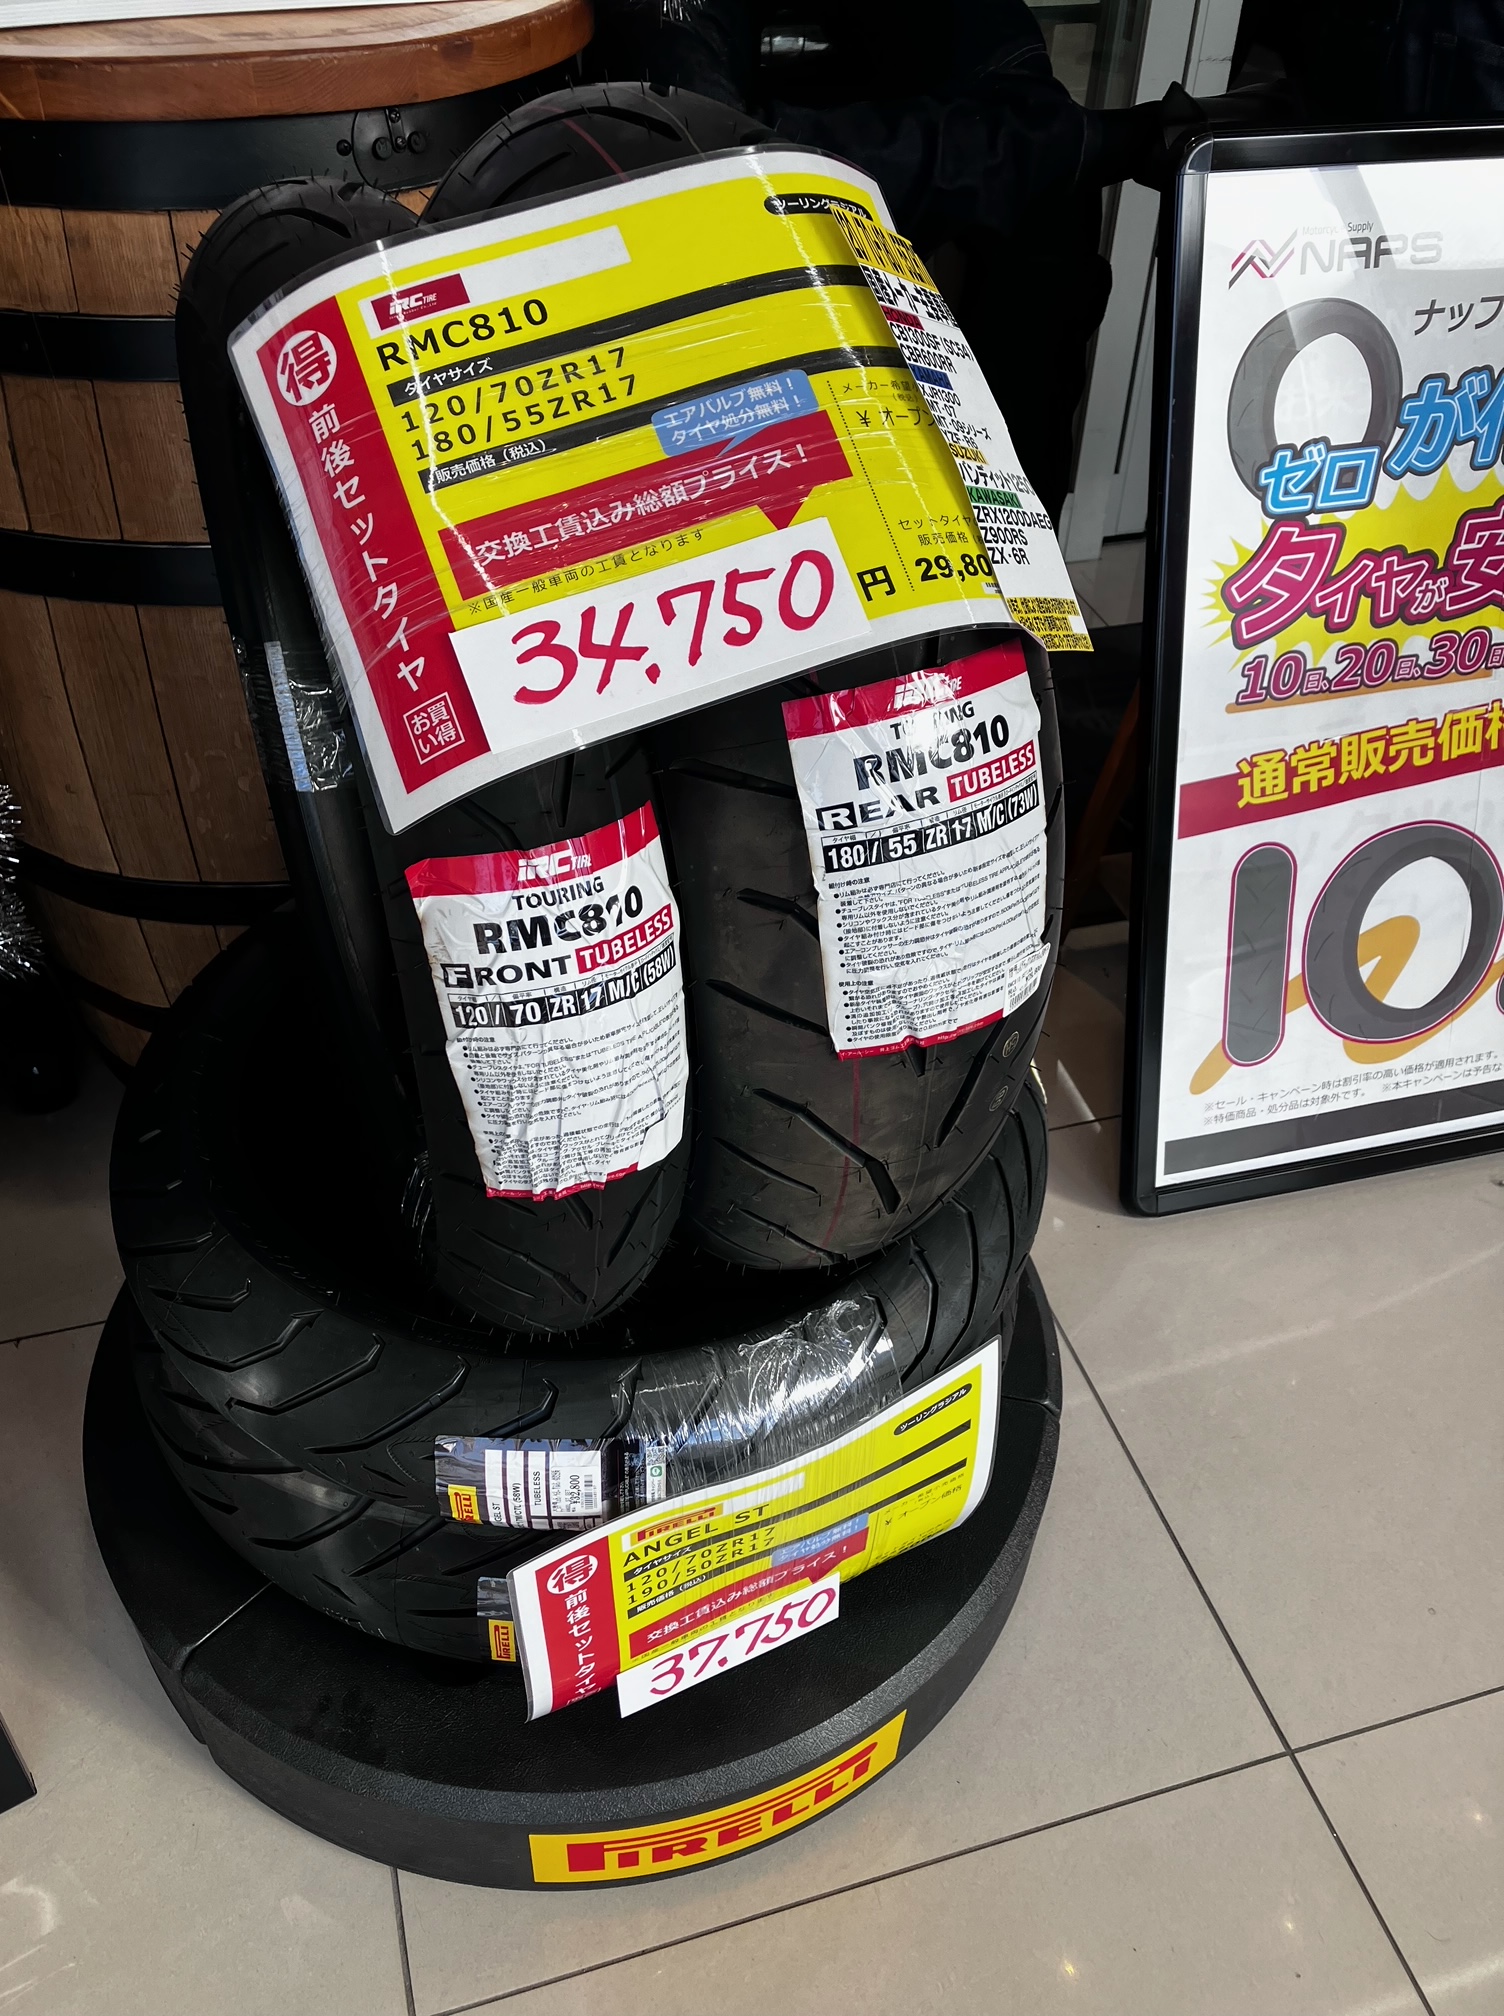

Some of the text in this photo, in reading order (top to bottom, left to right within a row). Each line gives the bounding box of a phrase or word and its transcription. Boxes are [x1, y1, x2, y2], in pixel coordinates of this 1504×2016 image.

[1347, 221, 1374, 233] Supply
[1300, 231, 1443, 275] NAPS
[376, 299, 549, 371] RMC810
[883, 306, 923, 330] HONDA
[890, 322, 975, 362] CB1300SF (SC54)
[900, 343, 957, 374] CBR600RR
[280, 333, 333, 403] 得
[401, 346, 625, 432] 120/70ZR17
[404, 358, 493, 396] タイヤサイズ
[909, 364, 953, 390] YAMAHA
[411, 374, 635, 461] 180/55ZR17
[664, 377, 794, 429] エアバルブ無料！
[919, 383, 961, 406] XJR1300
[672, 395, 802, 446] タイヤ処分無料！
[950, 444, 987, 463] SUZUKI
[967, 487, 1021, 508] KAWASAKI
[1260, 443, 1382, 515] ゼロ
[476, 443, 808, 567] 交換工賃込み総額プライス！
[974, 505, 1053, 531] ZRX1200DAEG
[308, 403, 425, 692] 前後セットタイヤ
[980, 526, 1028, 545] Z900RS
[856, 564, 898, 604] 円
[853, 715, 1009, 790] RMC810
[819, 786, 941, 830] REAR
[951, 747, 1033, 799] TUBELESS
[828, 844, 867, 869] 180
[889, 833, 917, 859] 55
[926, 826, 949, 851] ZR
[951, 816, 972, 841] 17
[977, 801, 1005, 834] M/C
[1008, 783, 1038, 820] (73W)
[512, 876, 604, 910] TOURING
[446, 954, 572, 988] FRONT
[578, 908, 672, 970] TUBELESS
[455, 1005, 489, 1027] 120
[510, 1001, 541, 1024] 70
[550, 996, 577, 1018] ZR
[581, 983, 605, 1011] 17
[643, 949, 675, 987] (58W)
[533, 1471, 541, 1506] TUBELESS
[623, 1504, 769, 1567] ANGEL ST
[637, 1506, 716, 1542] PIRELLI
[552, 1555, 593, 1593] 得
[626, 1526, 776, 1592] 120/70ZR17
[627, 1537, 775, 1605] 190/50ZR17
[633, 1546, 692, 1576] タイヤサイズ
[494, 1625, 511, 1660] PIRELLI
[564, 1588, 597, 1694] 前後セットタイヤ
[566, 1741, 878, 1873] PIRELLI
